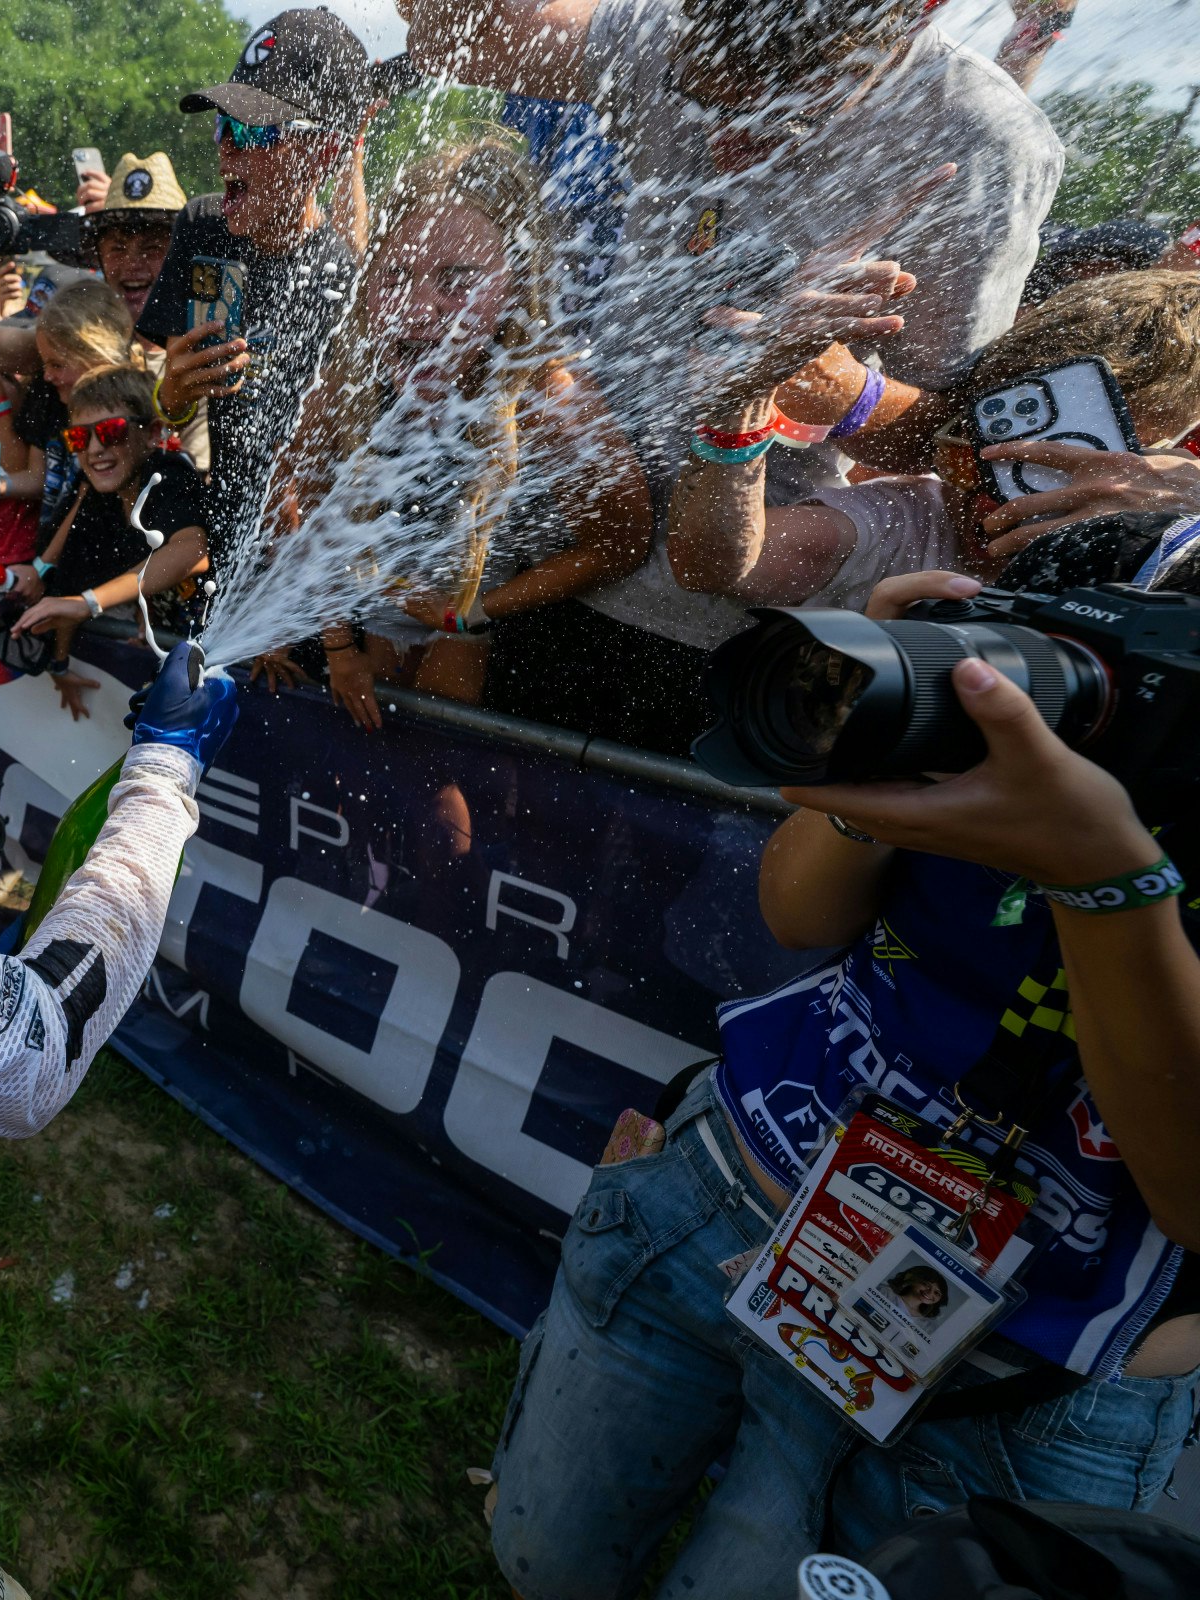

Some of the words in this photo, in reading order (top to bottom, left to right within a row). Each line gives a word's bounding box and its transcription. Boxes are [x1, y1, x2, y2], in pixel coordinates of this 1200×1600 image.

[1060, 601, 1124, 623] SONY
[862, 1132, 1002, 1218] MOTOCROS
[777, 1216, 793, 1238] CREEK
[788, 1199, 804, 1219] MEDIA
[799, 1185, 811, 1205] MAP
[851, 1193, 880, 1214] SPRING
[934, 1249, 966, 1277] MEDIA
[751, 1283, 771, 1308] FXR
[777, 1265, 906, 1380] PRESS
[867, 1287, 892, 1309] SOPHIA
[892, 1309, 933, 1346] MARSCHALL
